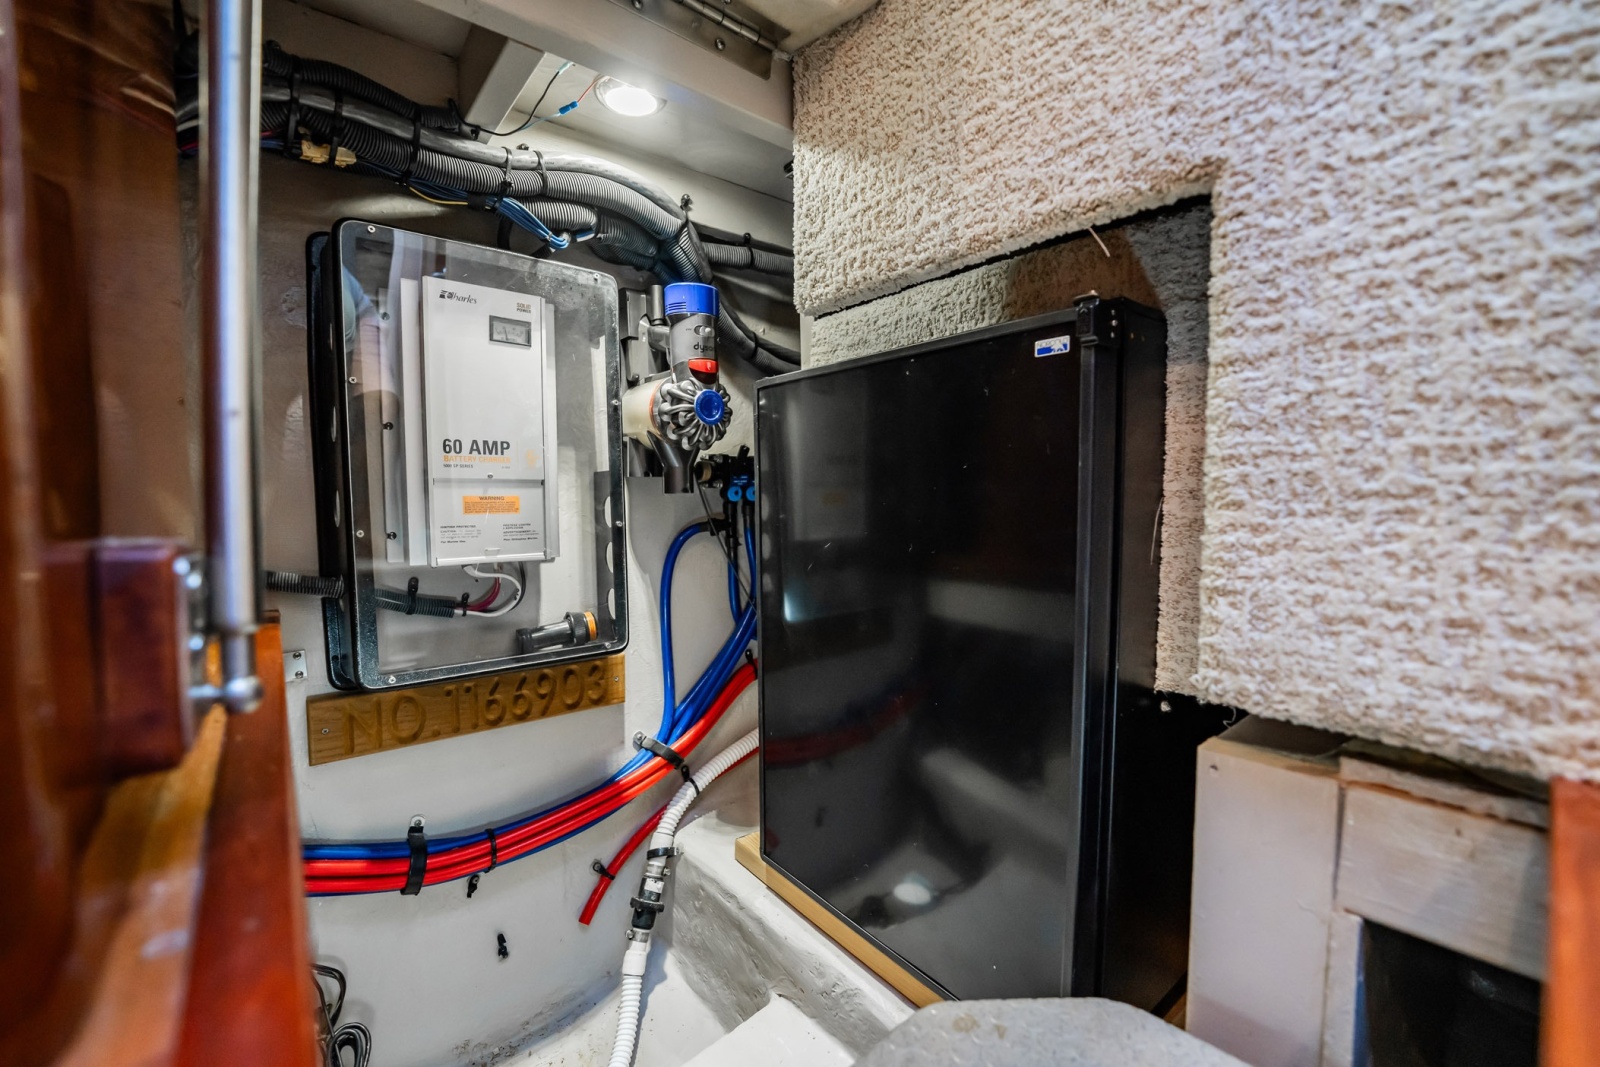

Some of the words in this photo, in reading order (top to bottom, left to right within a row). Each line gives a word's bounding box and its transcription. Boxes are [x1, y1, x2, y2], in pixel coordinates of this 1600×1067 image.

[693, 342, 715, 353] dyso
[442, 438, 463, 454] 60
[468, 439, 511, 456] AMP
[443, 455, 477, 463] BATTERY
